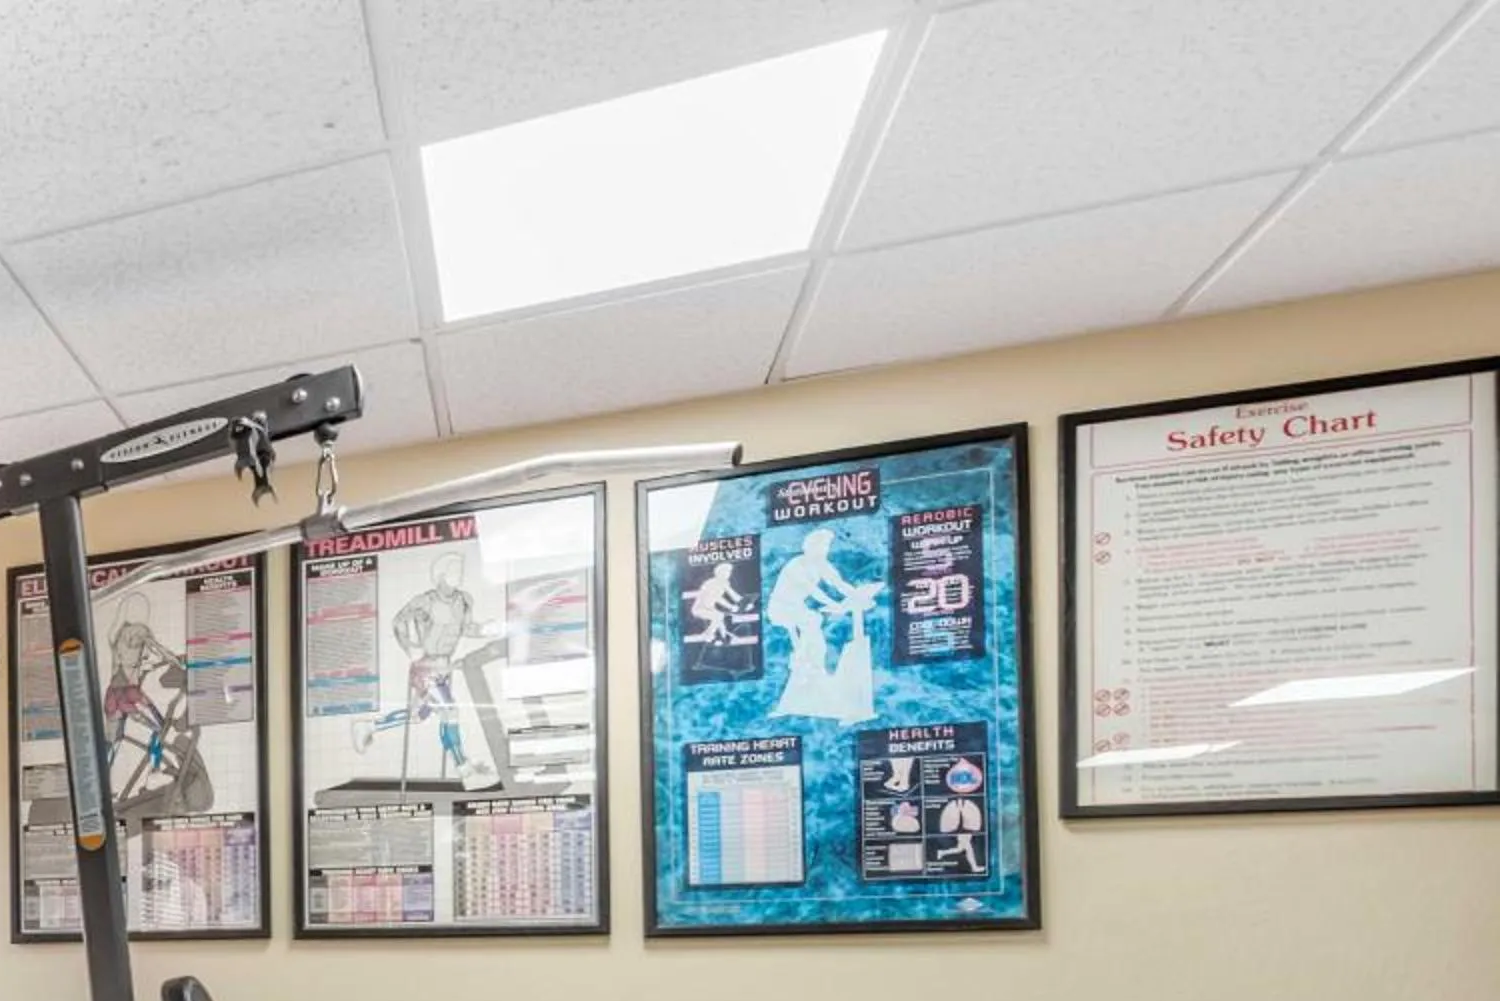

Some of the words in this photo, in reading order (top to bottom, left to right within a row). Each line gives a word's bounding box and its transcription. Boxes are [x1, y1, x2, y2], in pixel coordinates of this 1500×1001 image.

[1235, 401, 1309, 419] Exercise
[1166, 424, 1265, 451] Safety
[1283, 409, 1376, 437] Chart
[774, 495, 877, 521] WORKOUT
[901, 507, 973, 526] AEROBIC
[902, 519, 972, 537] WORKOUT
[305, 523, 443, 557] TREADMILL
[690, 535, 753, 553] USCLES
[688, 547, 753, 566] INVOLVED
[904, 573, 970, 614] 20
[889, 725, 955, 741] HEALTH
[690, 741, 750, 755] TRAINING
[753, 737, 797, 751] HEART
[888, 739, 955, 753] BENEFITS
[703, 755, 736, 766] RATE
[740, 751, 785, 765] ZONES
